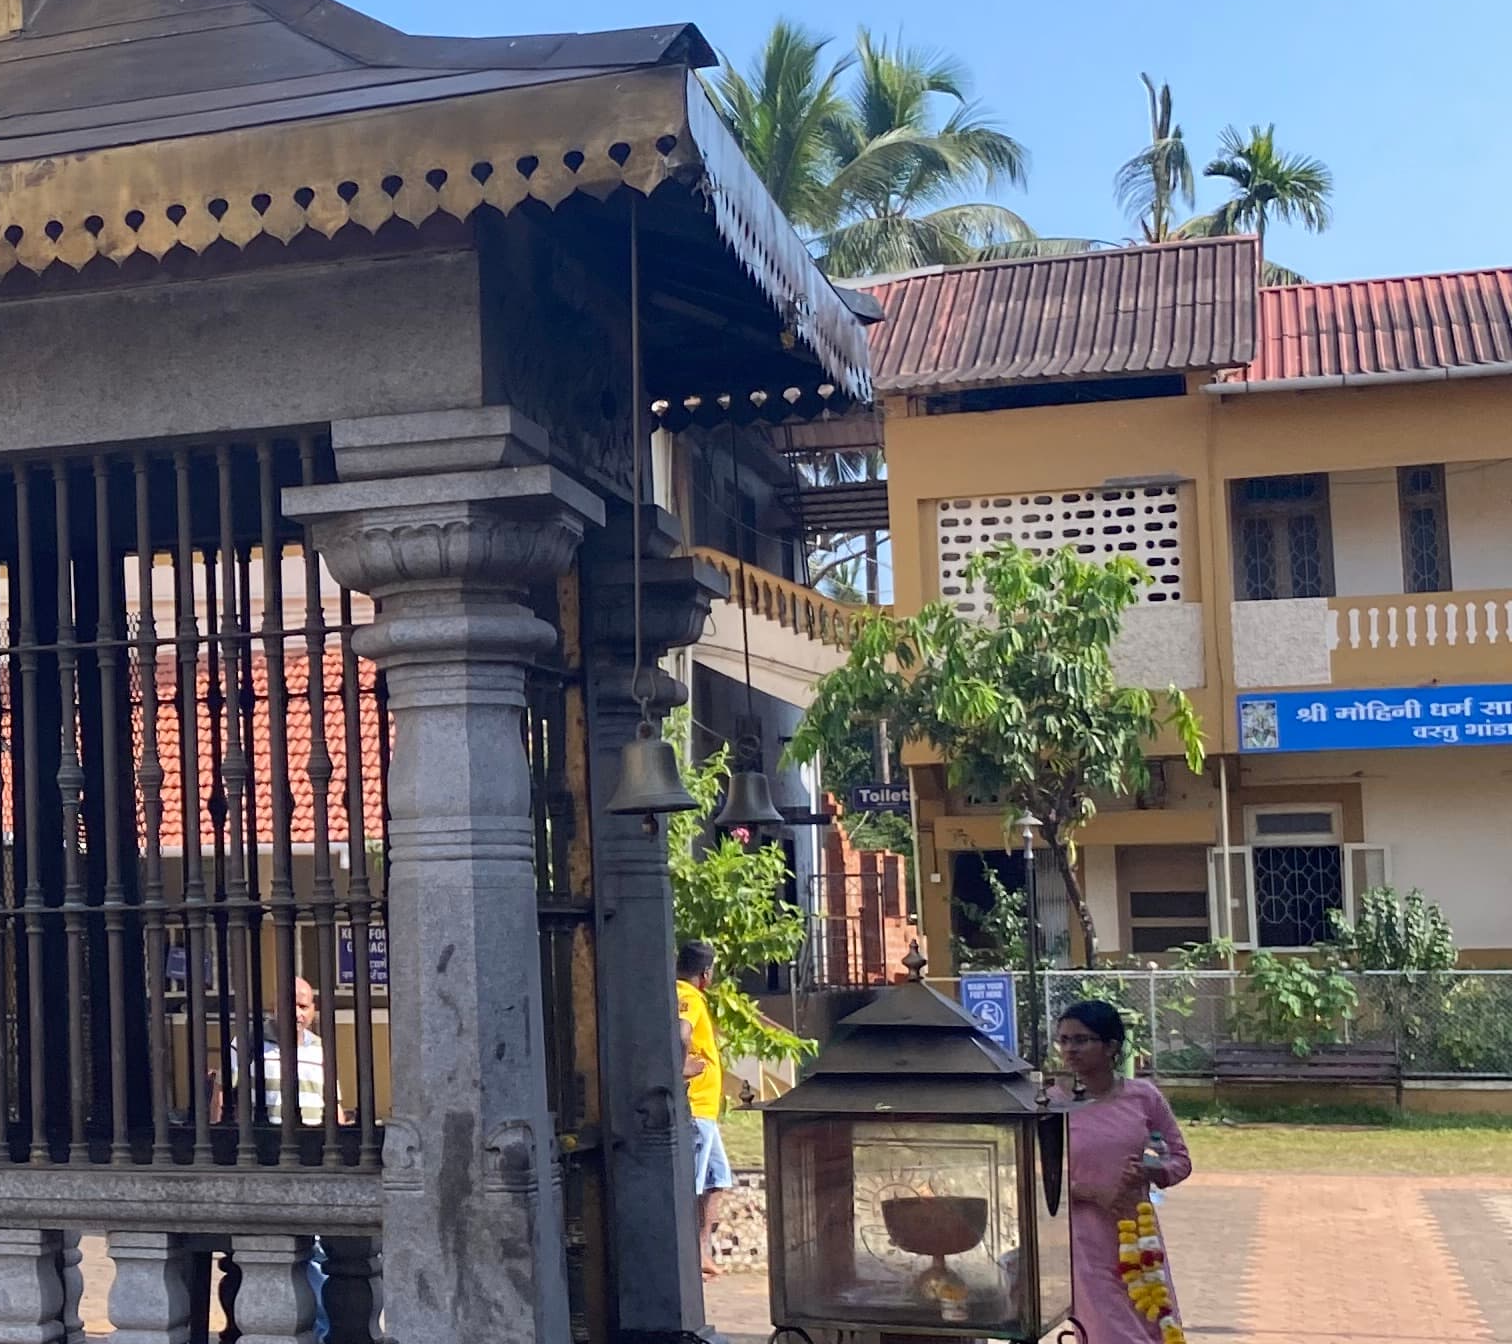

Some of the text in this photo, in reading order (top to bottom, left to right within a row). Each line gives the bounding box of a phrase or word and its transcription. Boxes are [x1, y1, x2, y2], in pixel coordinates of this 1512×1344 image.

[1295, 702, 1327, 723] श्री
[1335, 698, 1421, 722] मोहिनी
[1429, 696, 1473, 718] धर्म
[1412, 723, 1459, 743] वस्तु
